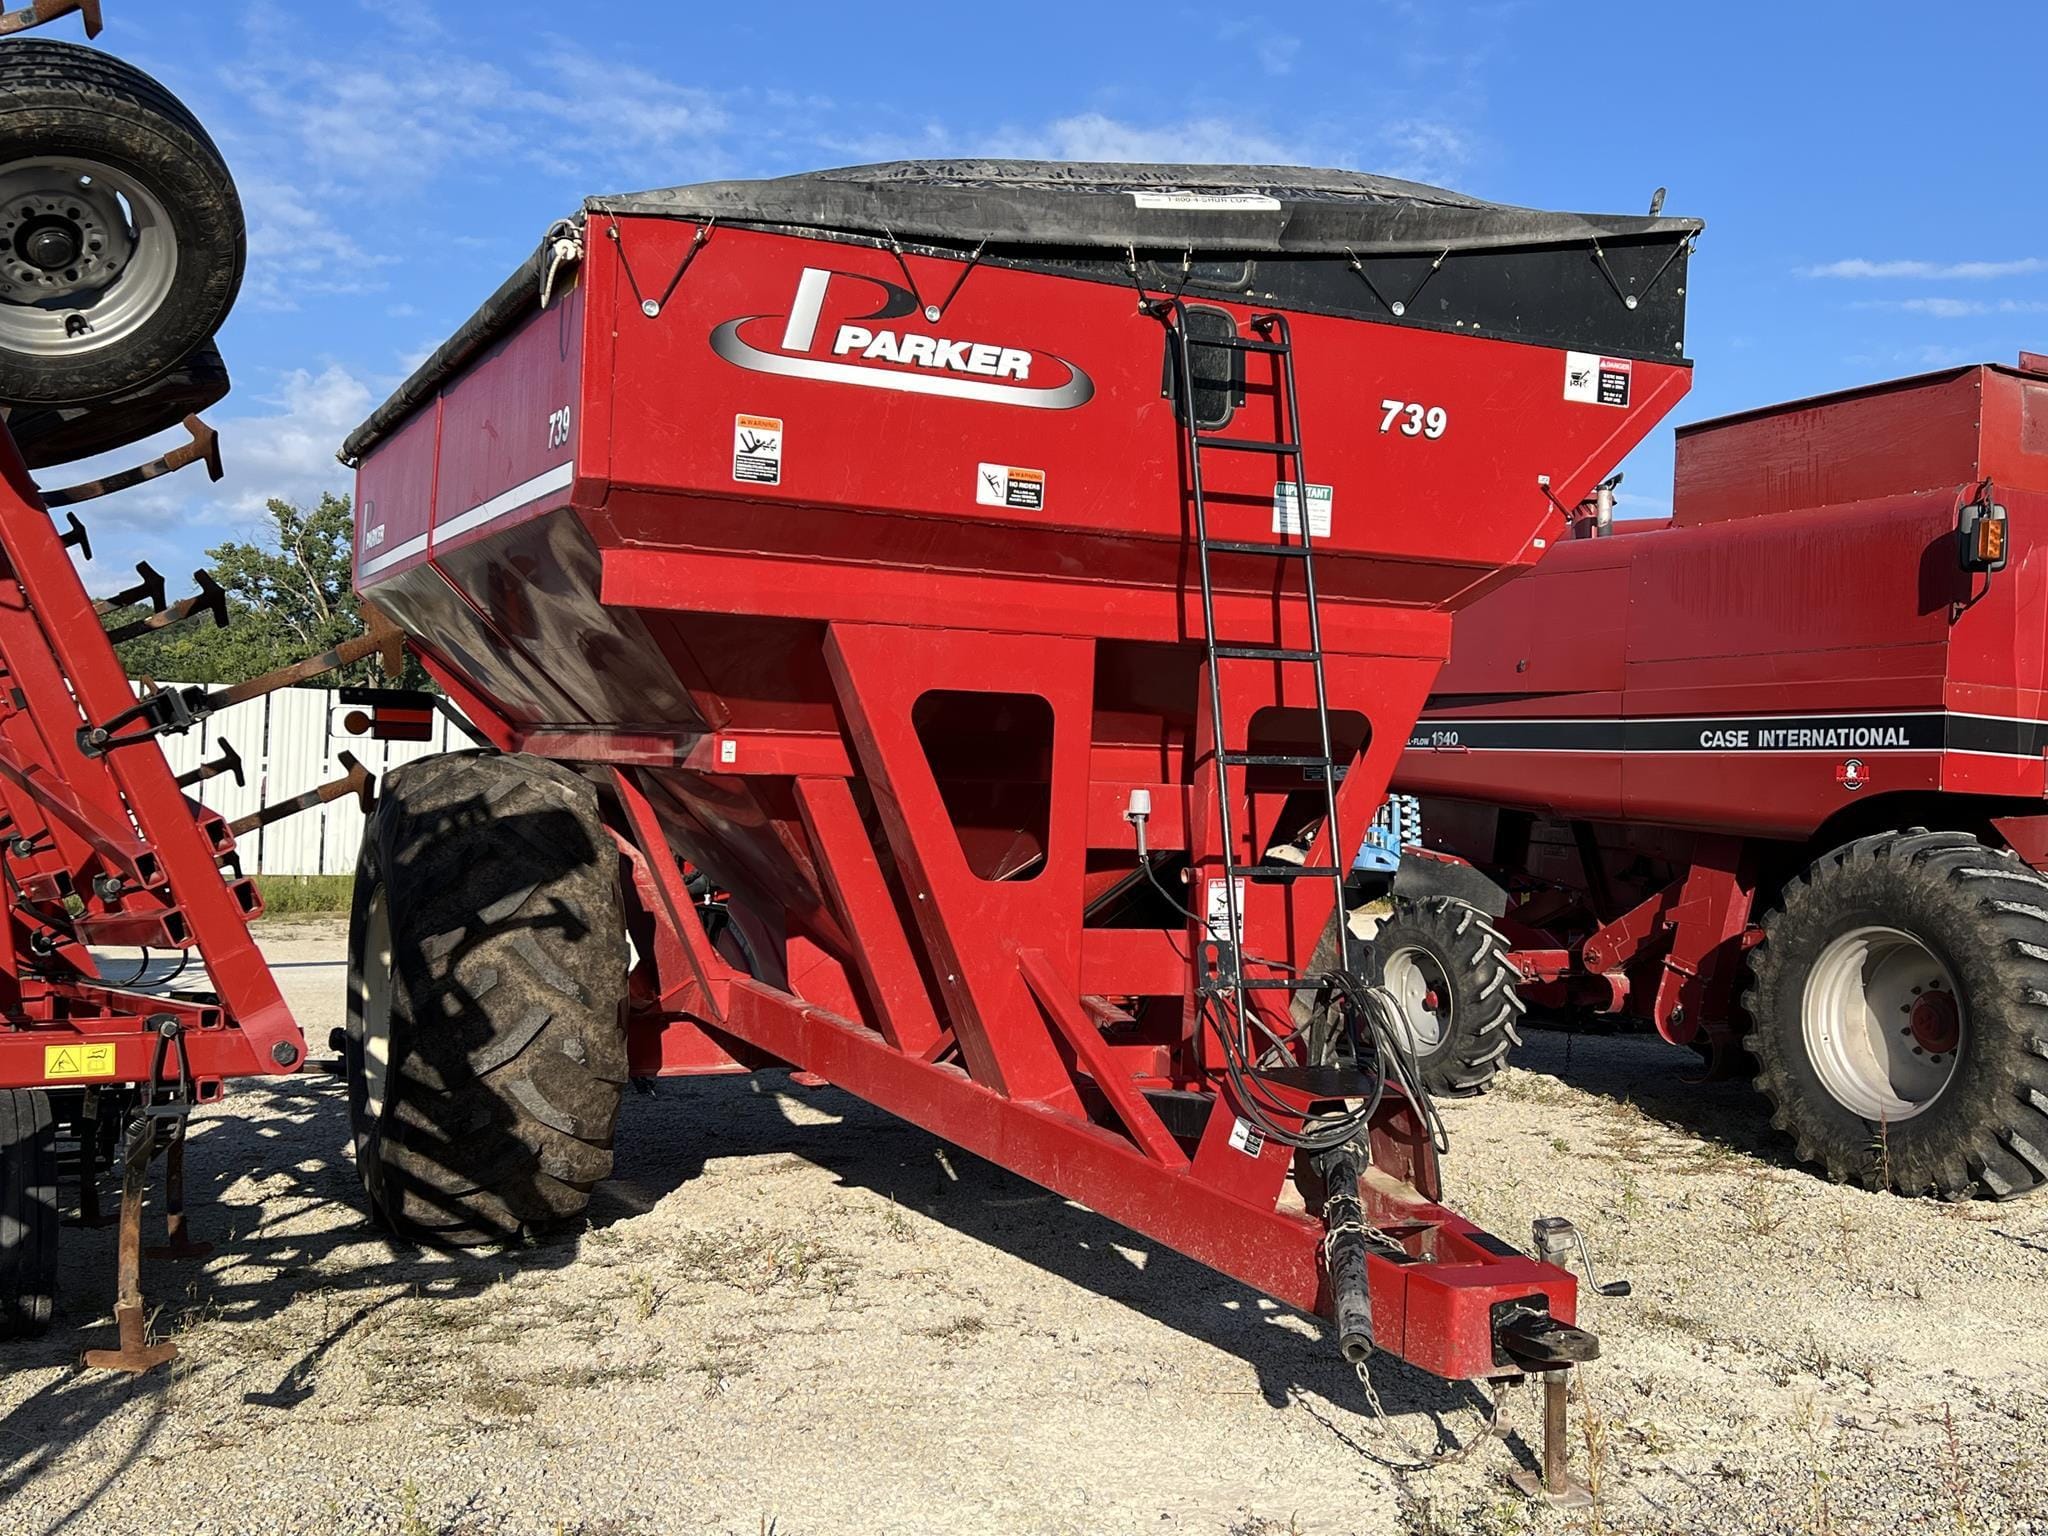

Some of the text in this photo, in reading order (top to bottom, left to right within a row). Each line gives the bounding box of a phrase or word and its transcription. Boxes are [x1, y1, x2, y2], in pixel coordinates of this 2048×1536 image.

[832, 324, 1033, 381] PARKER
[549, 405, 570, 449] 739
[748, 420, 778, 428] WARNING
[1380, 399, 1447, 439] 739
[1015, 472, 1042, 480] WARNING
[1700, 727, 1910, 748] CASE INTERNATIONAL
